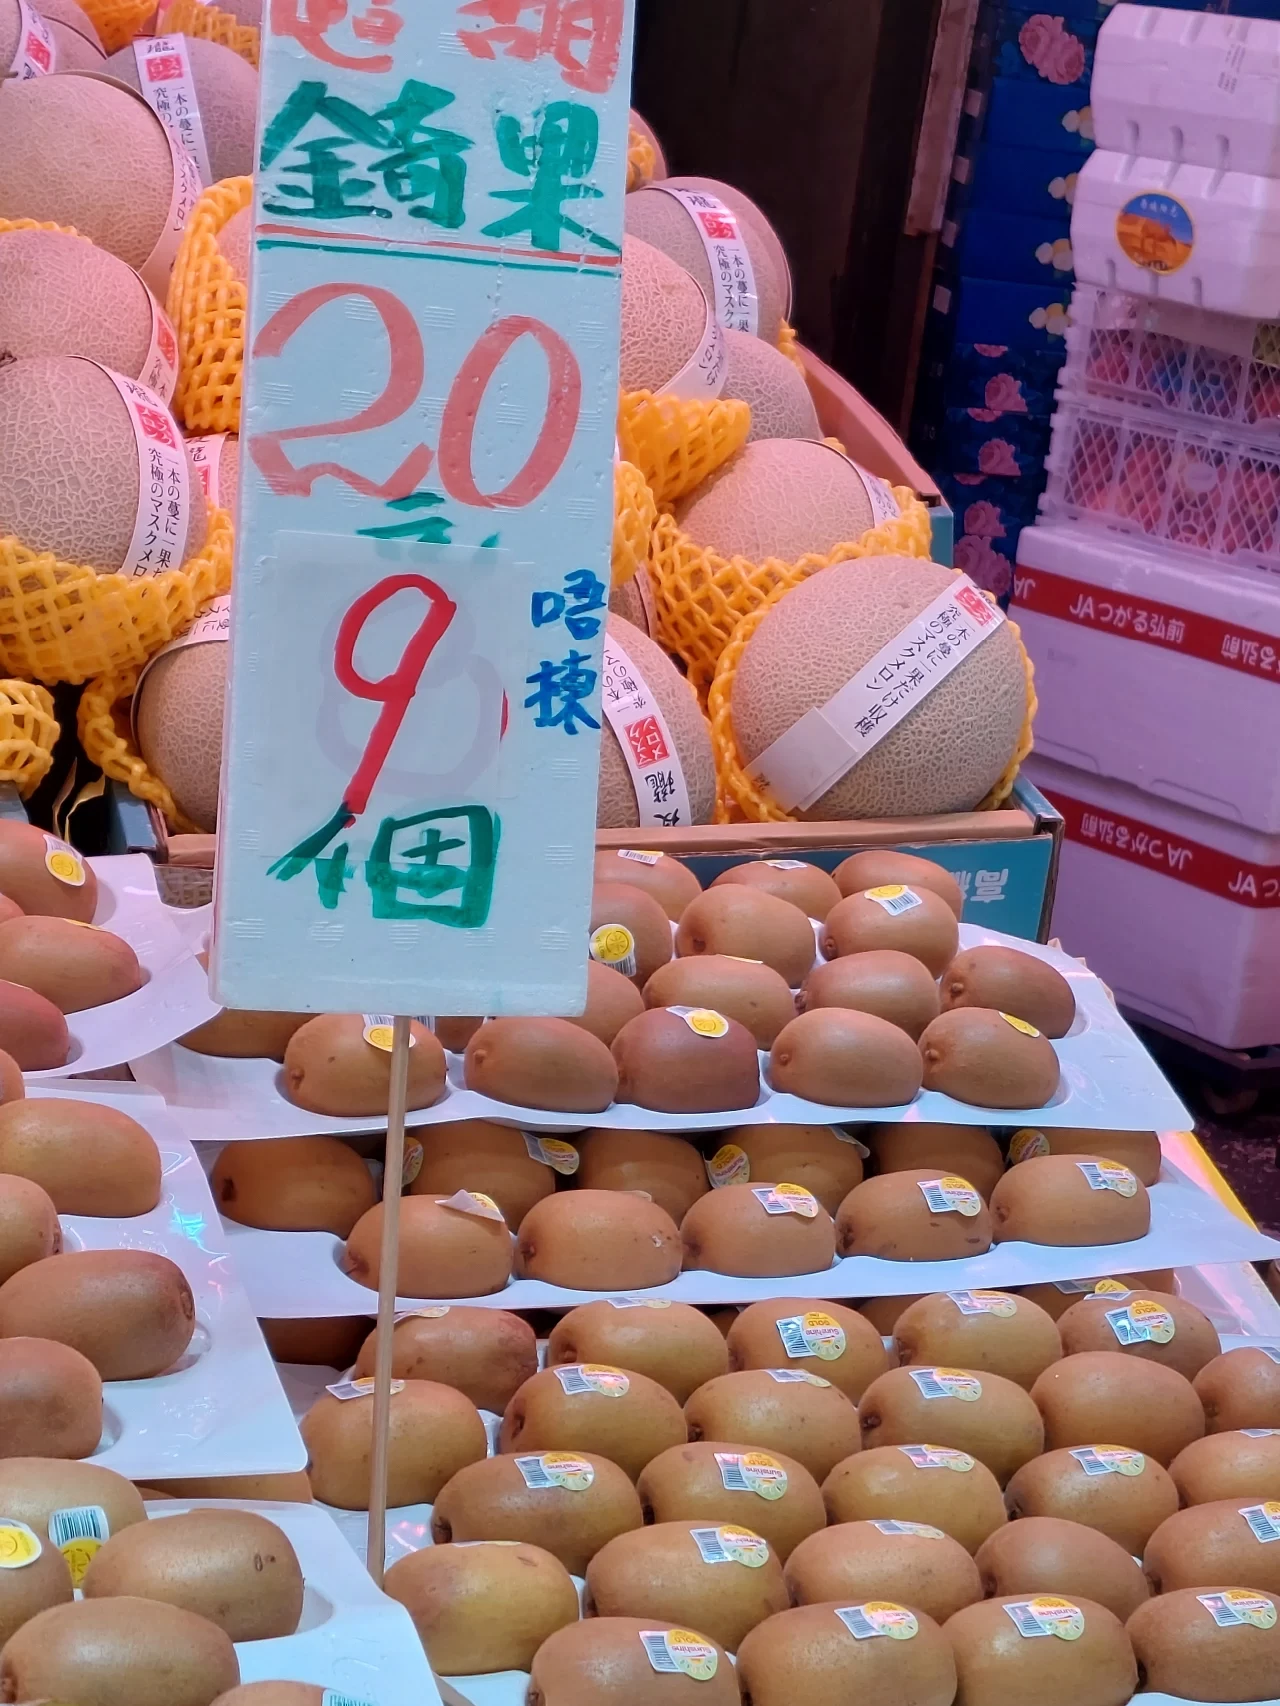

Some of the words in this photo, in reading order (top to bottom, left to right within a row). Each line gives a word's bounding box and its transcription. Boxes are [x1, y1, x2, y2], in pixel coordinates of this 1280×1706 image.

[153, 86, 173, 128] 究極の
[248, 282, 582, 508] 20
[865, 601, 962, 691] 究極のマスクメロン
[1221, 634, 1280, 671] る弘前
[332, 573, 457, 822] 9
[854, 620, 977, 738] 一本の蔓に一果だけ収穫
[266, 801, 501, 929] 個
[1134, 1313, 1168, 1323] Sunshine
[1135, 1307, 1157, 1315] GOLD
[746, 1467, 782, 1477] Sunshine
[671, 1645, 712, 1654] Sunshine
